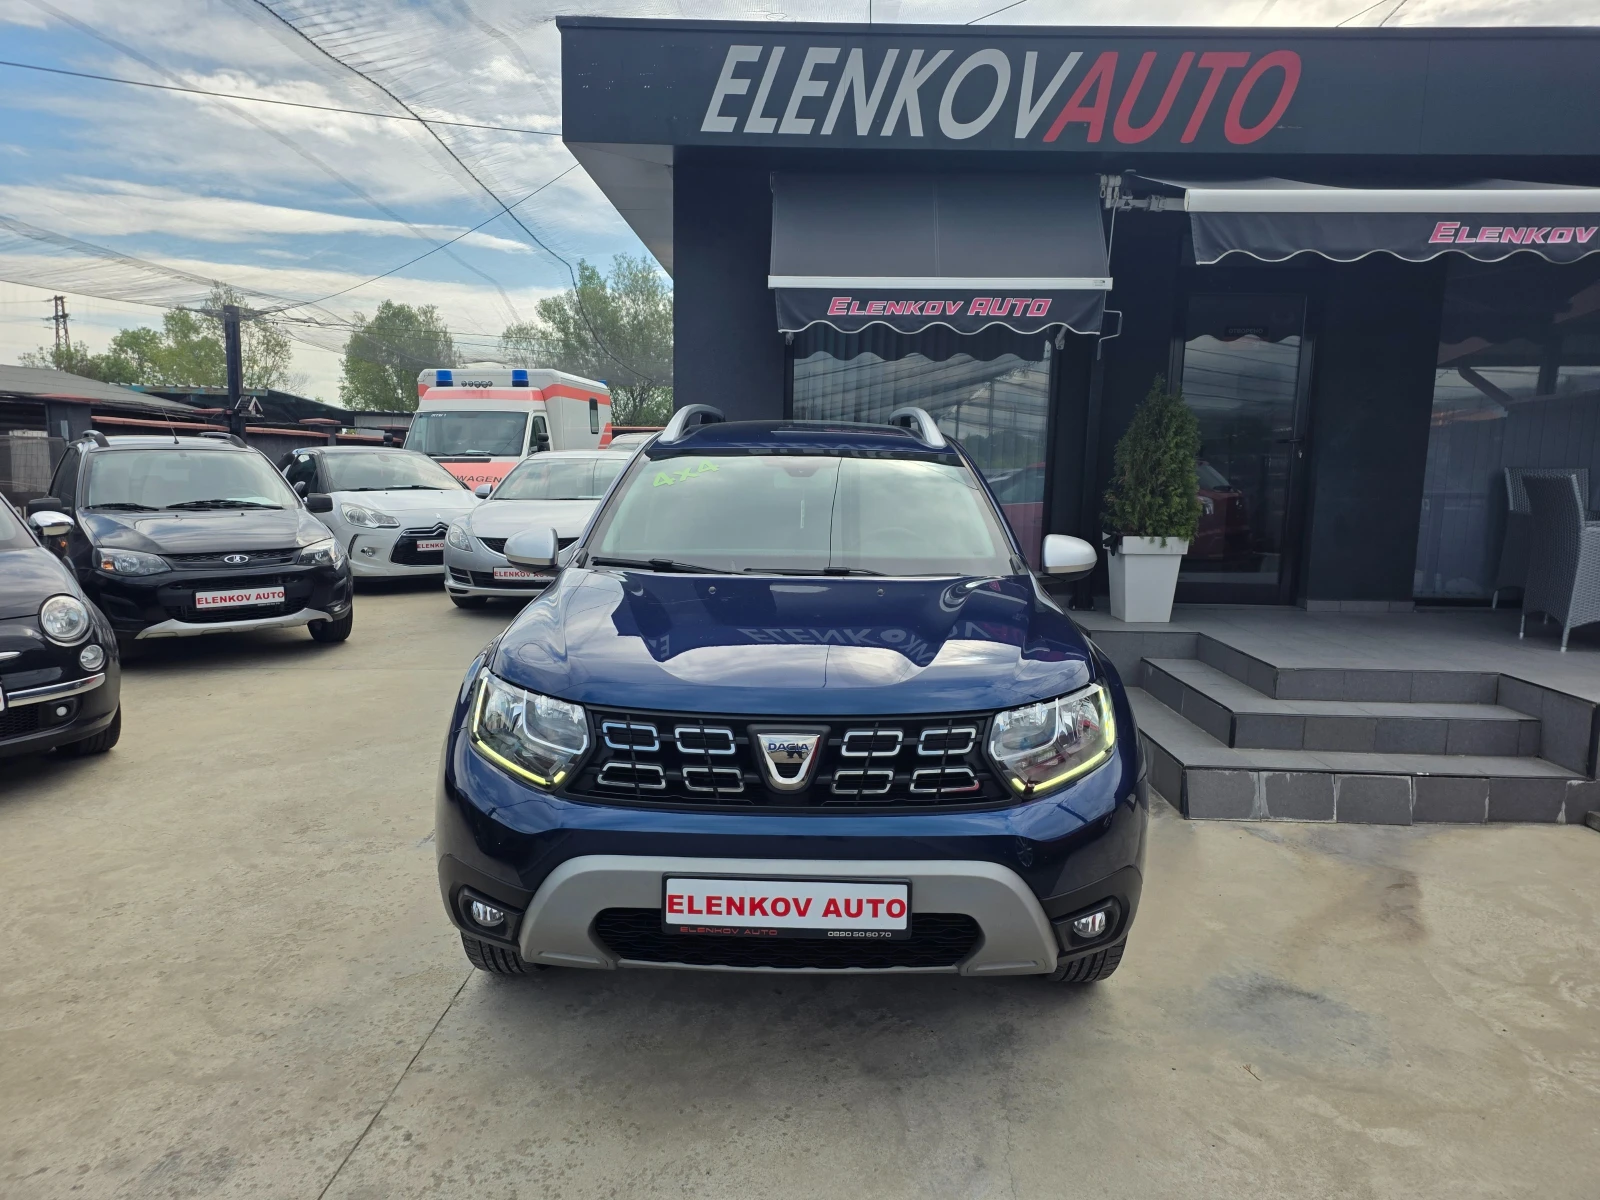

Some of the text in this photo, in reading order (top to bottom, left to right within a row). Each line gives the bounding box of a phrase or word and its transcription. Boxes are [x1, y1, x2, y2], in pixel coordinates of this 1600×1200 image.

[1428, 221, 1599, 244] ELENKOV
[827, 296, 1053, 317] ELENKOV AUTO
[197, 591, 285, 605] ELENKOV AUTO
[768, 743, 809, 751] DACIA
[667, 894, 907, 919] ELENKOV AUTO
[680, 926, 740, 934] ELENKOV
